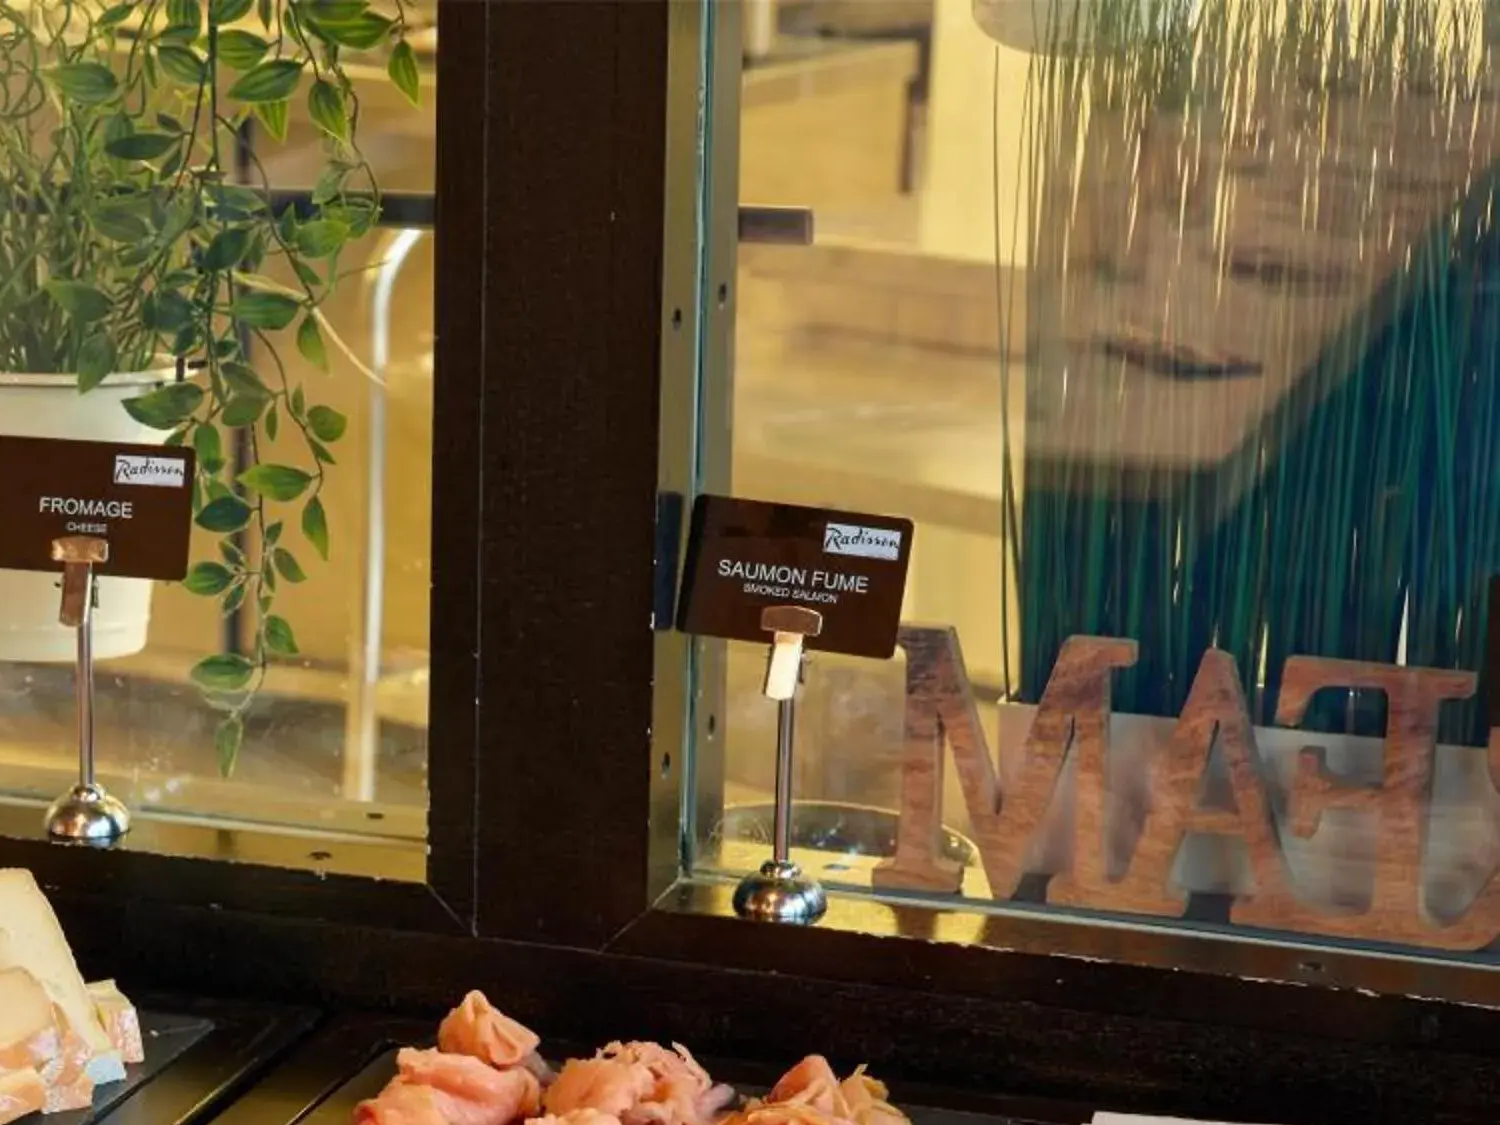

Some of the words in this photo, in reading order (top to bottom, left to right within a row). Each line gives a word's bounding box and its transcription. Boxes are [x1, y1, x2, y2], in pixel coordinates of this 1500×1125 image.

[115, 456, 184, 480] Radisson
[39, 496, 134, 519] FROMAGE
[66, 521, 108, 533] CHEESE
[825, 525, 899, 550] Radisson
[717, 558, 806, 585] SAUMON
[811, 570, 869, 594] FUME
[743, 583, 790, 599] SMOKED
[792, 588, 838, 604] SALMON
